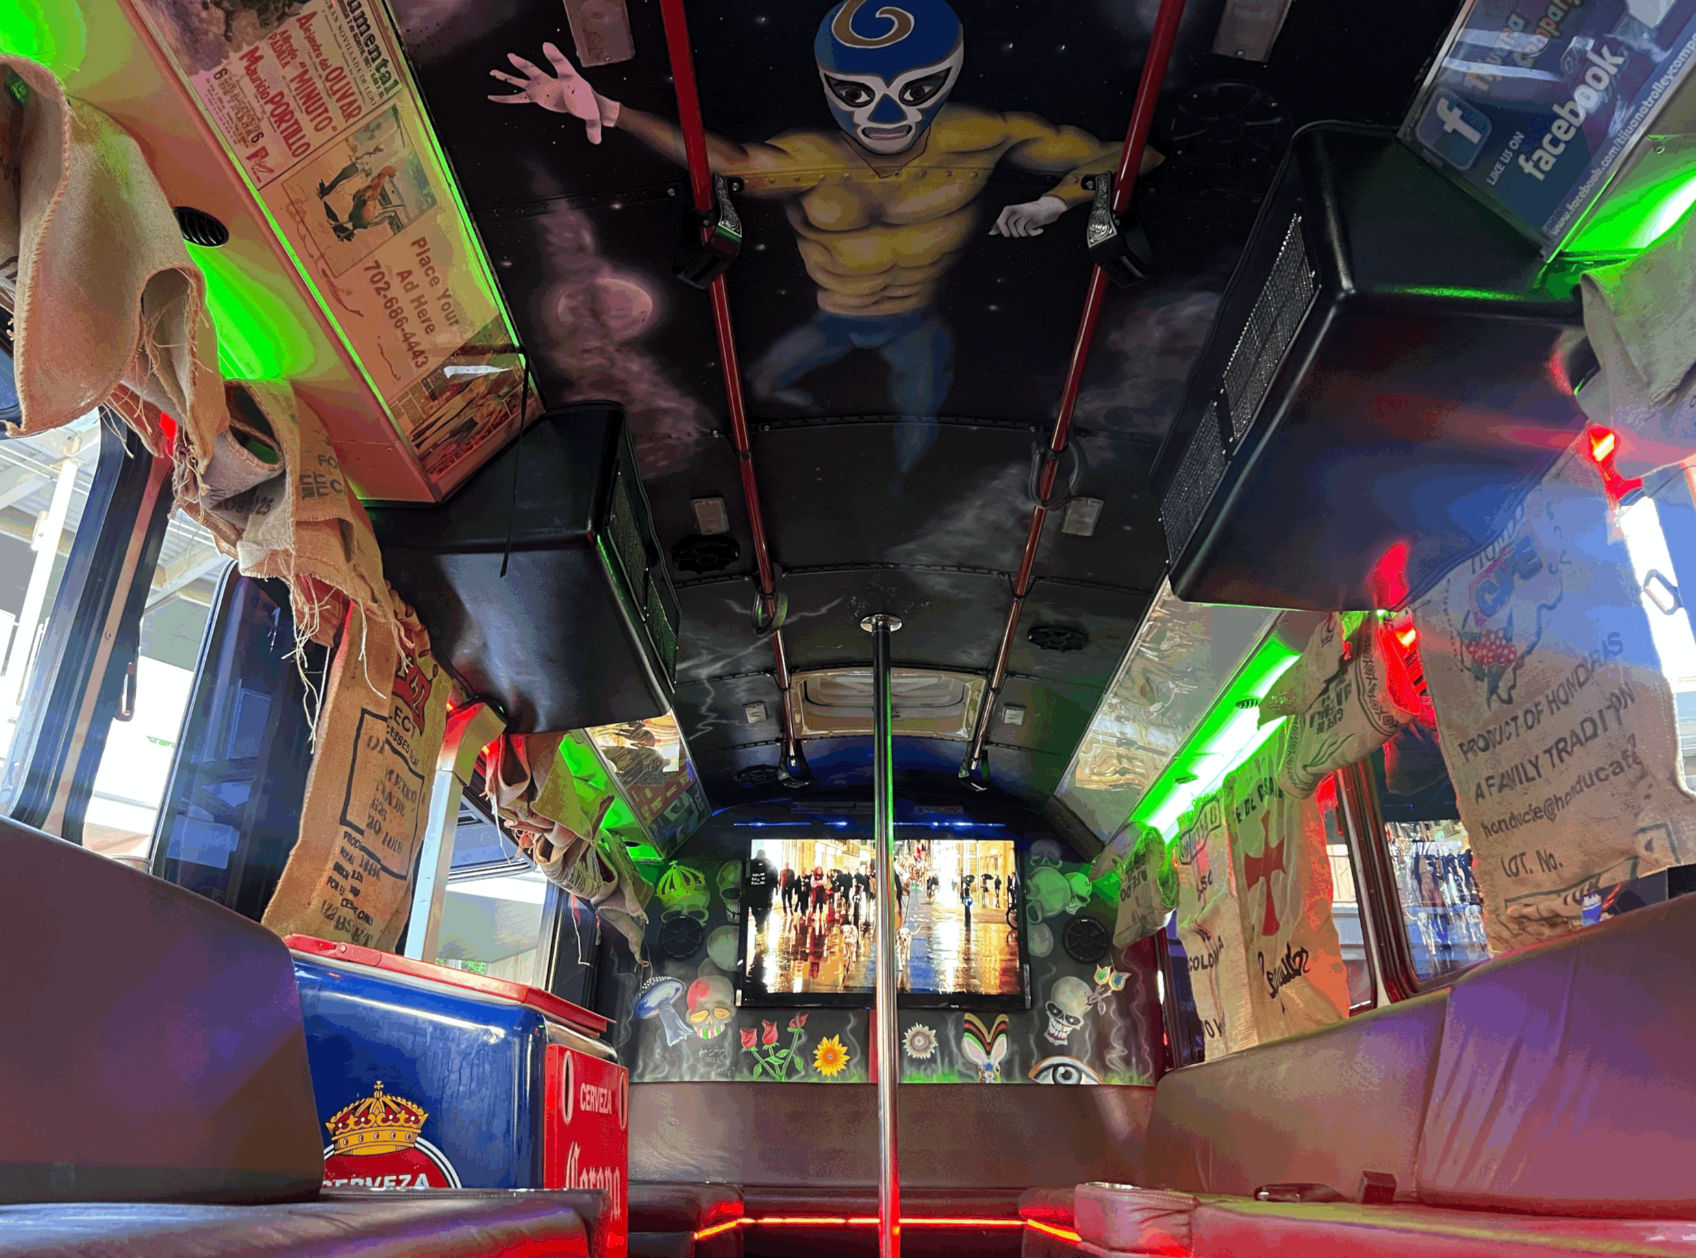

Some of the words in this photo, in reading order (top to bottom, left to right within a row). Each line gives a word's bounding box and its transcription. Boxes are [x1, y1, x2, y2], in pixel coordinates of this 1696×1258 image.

[267, 32, 291, 69] PADILLA
[296, 11, 322, 59] Alejandro
[338, 23, 361, 74] NOVILLADA
[213, 68, 228, 80] 6
[318, 58, 333, 72] del
[239, 46, 271, 101] Mauricio
[264, 91, 311, 158] PORTILLO
[325, 66, 362, 123] OLIVAR
[1518, 45, 1626, 180] facebook
[251, 132, 264, 144] 6
[1486, 161, 1506, 186] LIKE
[1499, 148, 1514, 165] US
[1508, 131, 1525, 150] ON
[396, 269, 419, 293] Ad
[410, 294, 436, 335] Here
[411, 237, 440, 287] Place
[437, 287, 460, 327] Your
[364, 260, 430, 369] 702-686-4443
[1524, 701, 1544, 731] OF
[1474, 781, 1485, 806] A
[1501, 851, 1535, 878] LOT.
[1538, 849, 1565, 875] No.
[579, 1082, 612, 1114] CERVEZA
